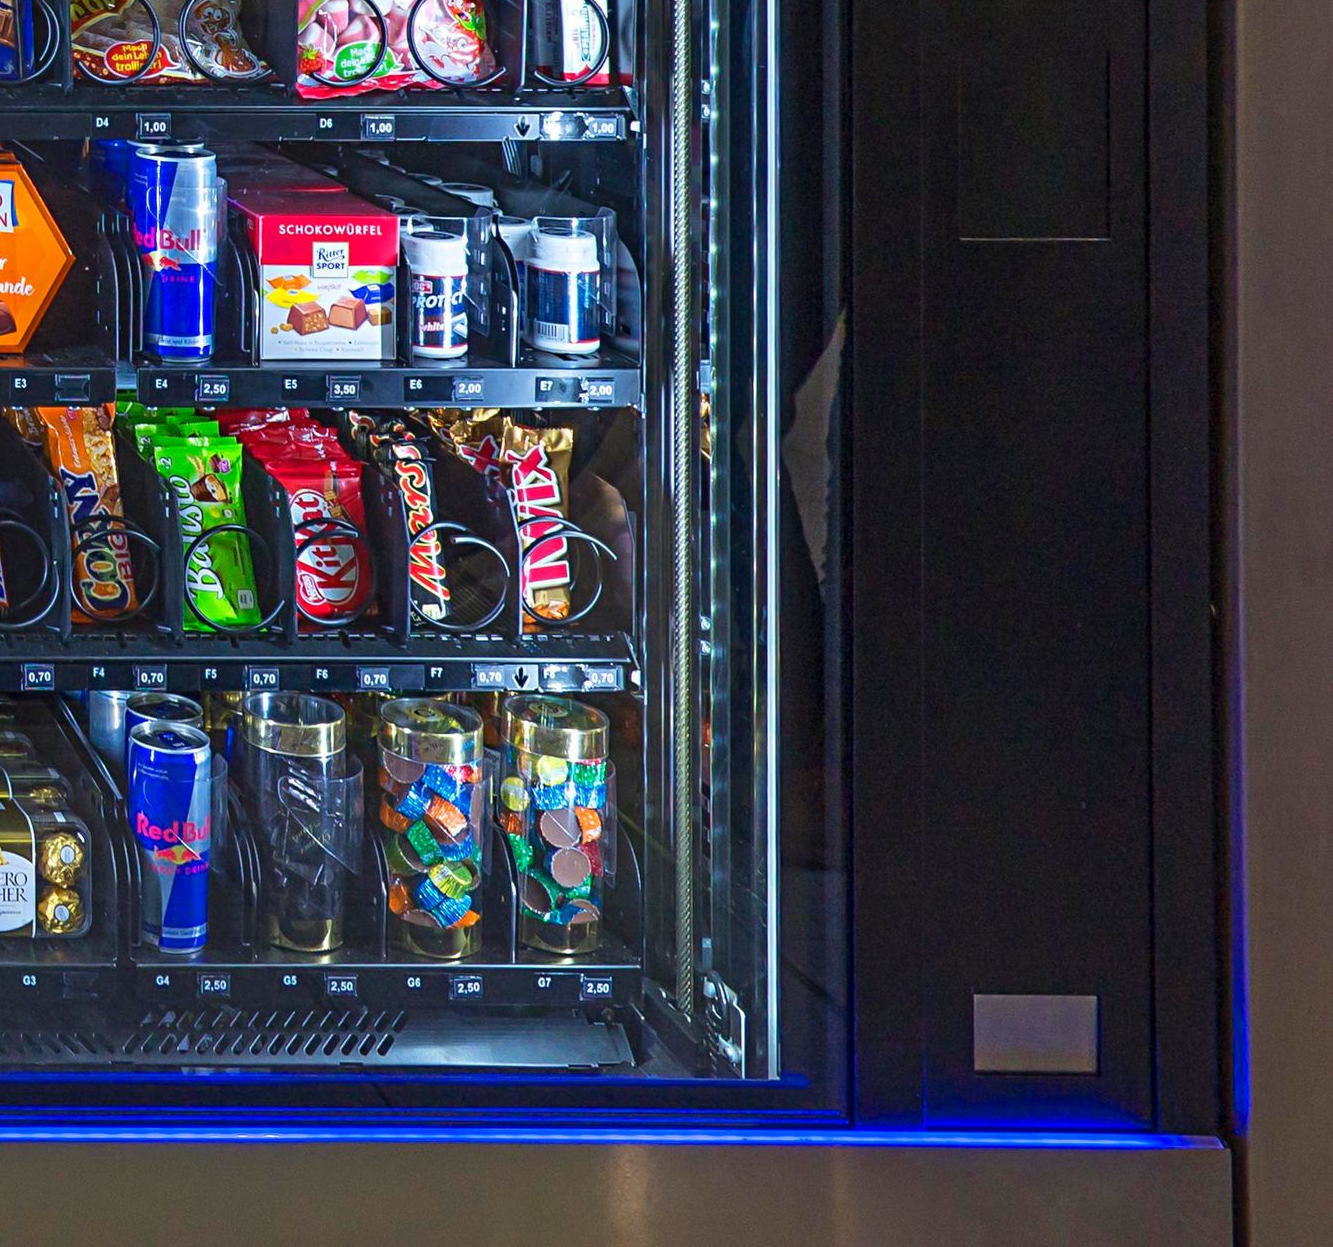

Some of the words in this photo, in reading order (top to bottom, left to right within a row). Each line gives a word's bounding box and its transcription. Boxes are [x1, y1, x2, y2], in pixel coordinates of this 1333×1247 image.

[278, 222, 383, 238] SCHOKOWÜRFEL
[159, 226, 201, 252] Bull
[315, 247, 345, 261] Ritter
[316, 261, 345, 271] SPORT
[205, 669, 218, 678] F5
[253, 673, 277, 686] 0,70
[137, 814, 177, 841] Red
